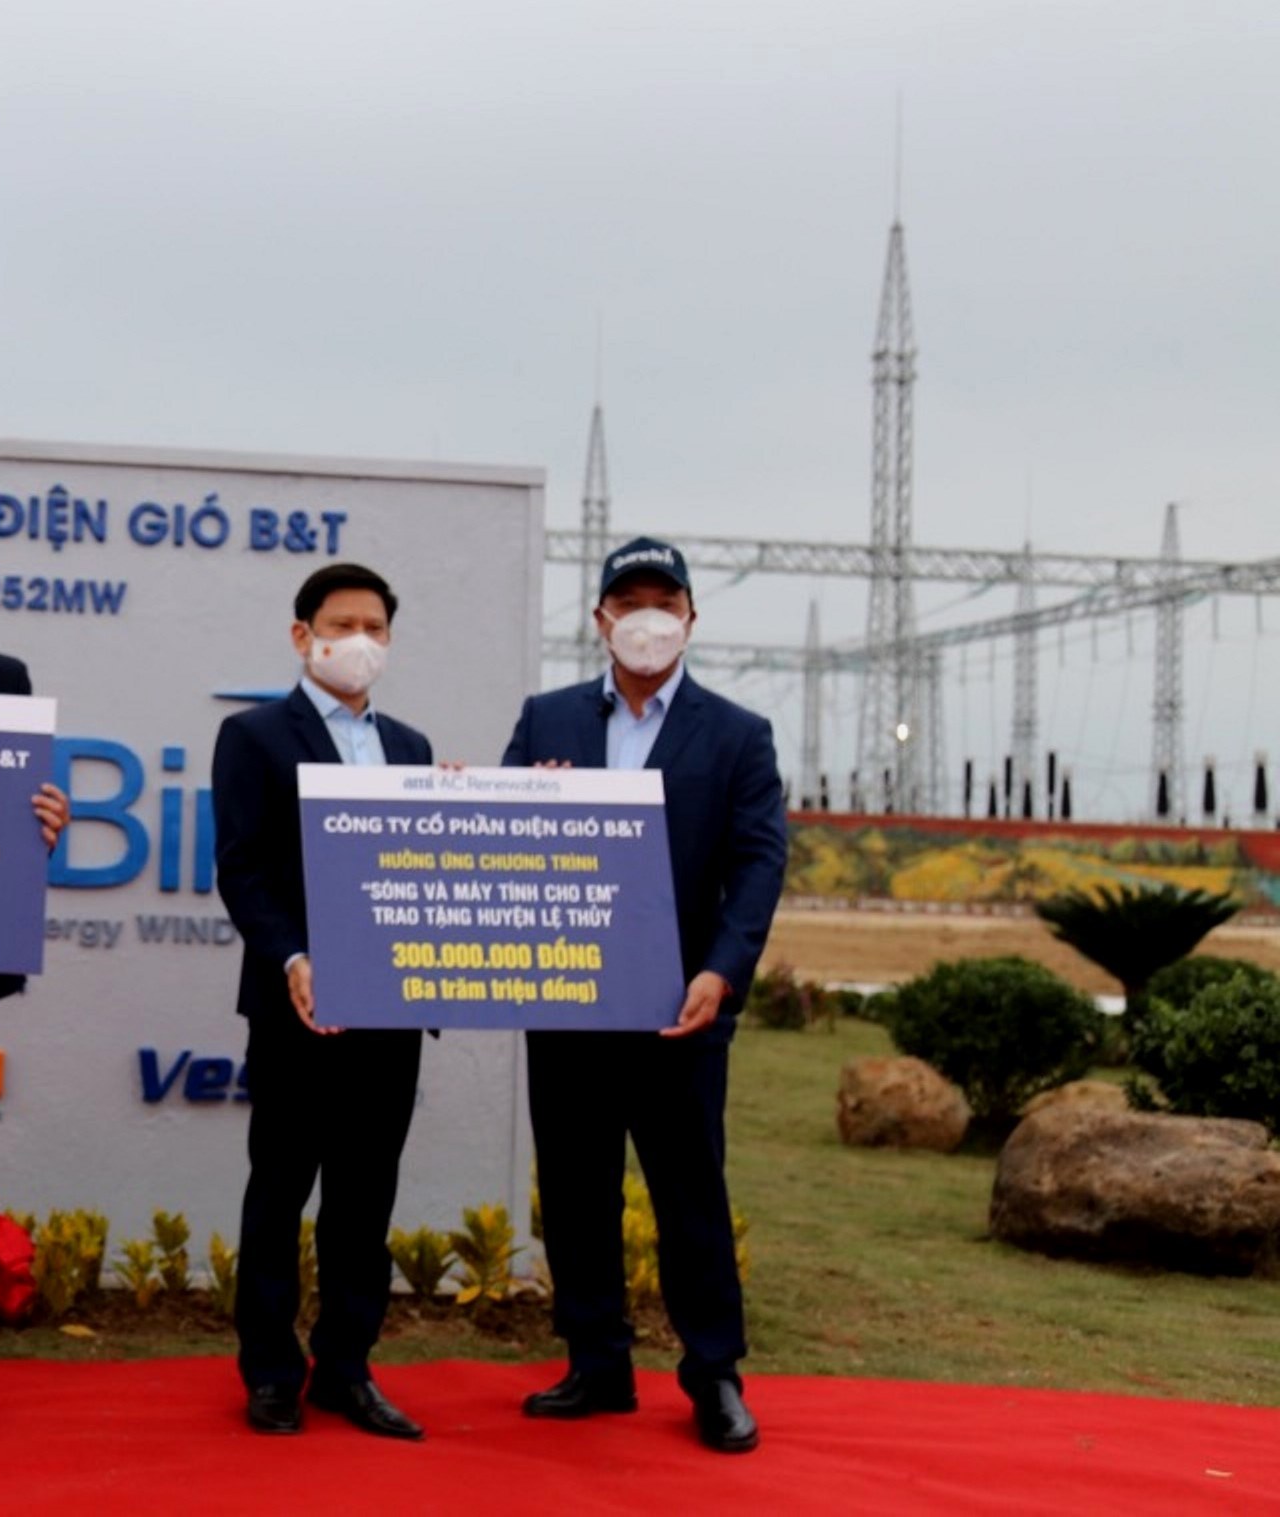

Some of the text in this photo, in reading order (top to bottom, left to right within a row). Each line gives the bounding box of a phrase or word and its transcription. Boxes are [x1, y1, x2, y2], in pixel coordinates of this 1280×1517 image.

[127, 495, 230, 548] GIÓ
[249, 509, 348, 554] B&T
[324, 813, 382, 833] CÔNG
[387, 817, 413, 833] TY
[449, 813, 506, 835] PHẦN
[510, 818, 558, 839] ĐIỆN
[562, 817, 599, 837] GIÓ
[604, 821, 645, 837] B&T
[424, 881, 448, 900] VÀ
[454, 881, 492, 900] MÁY
[498, 881, 538, 901] TÍNH
[544, 885, 580, 901] CHO
[47, 915, 237, 950] ergy WIND
[372, 907, 419, 925] TRAO
[478, 906, 536, 928] HUYỆN
[541, 906, 561, 930] LỆ
[392, 936, 602, 969] 300.000.000 ĐỒNG
[403, 976, 597, 1005] (Ba trăm triệu đồng)
